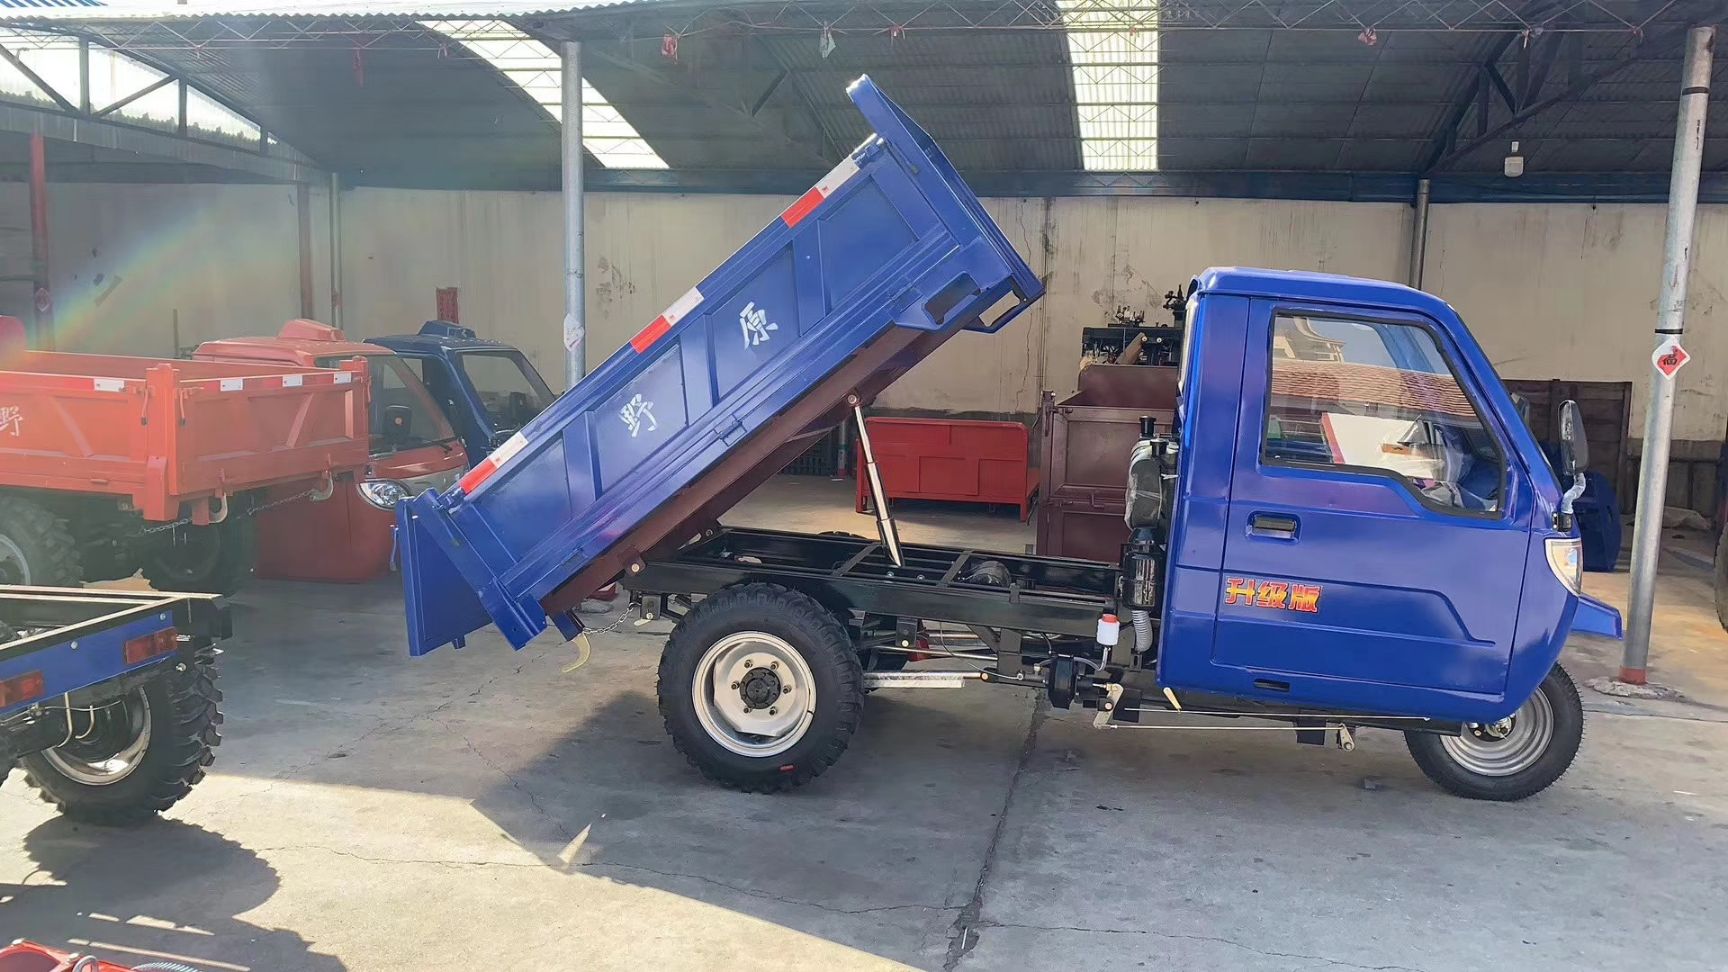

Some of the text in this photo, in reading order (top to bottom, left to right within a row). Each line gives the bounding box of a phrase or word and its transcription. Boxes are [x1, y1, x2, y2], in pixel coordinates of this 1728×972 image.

[618, 301, 779, 438] 野 原
[1225, 577, 1321, 613] 升级版
